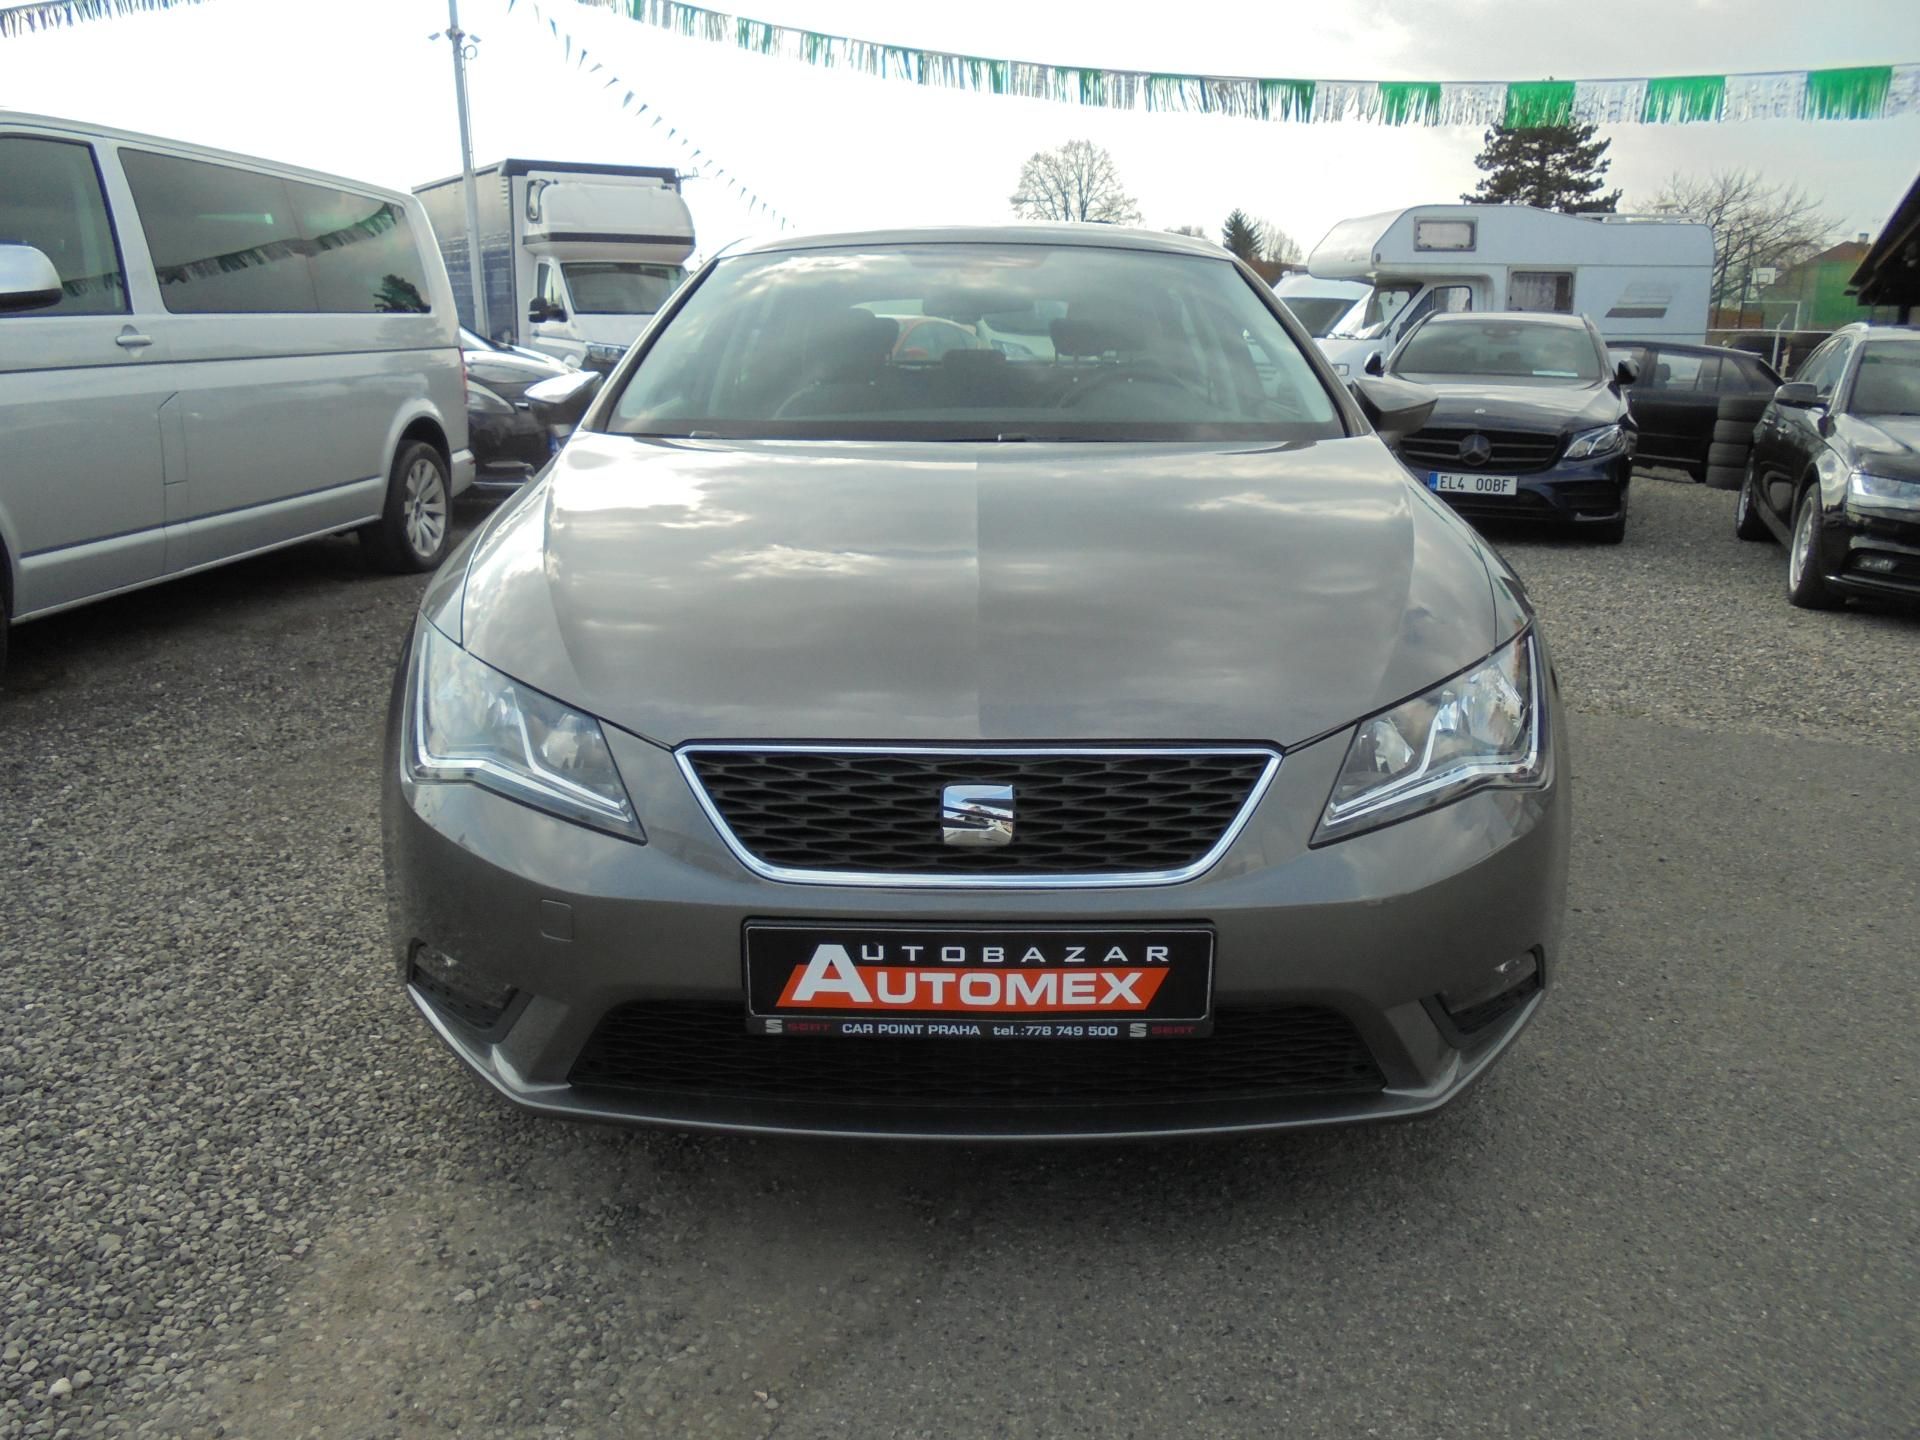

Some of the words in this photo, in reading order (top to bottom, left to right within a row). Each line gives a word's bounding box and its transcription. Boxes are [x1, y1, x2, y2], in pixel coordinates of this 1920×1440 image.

[1440, 475, 1465, 490] EL4
[842, 1023, 874, 1034] CAR
[878, 1024, 923, 1035] POINT
[928, 1024, 981, 1035] PRAHA
[1056, 1026, 1084, 1036] 749
[1088, 1026, 1118, 1036] 500
